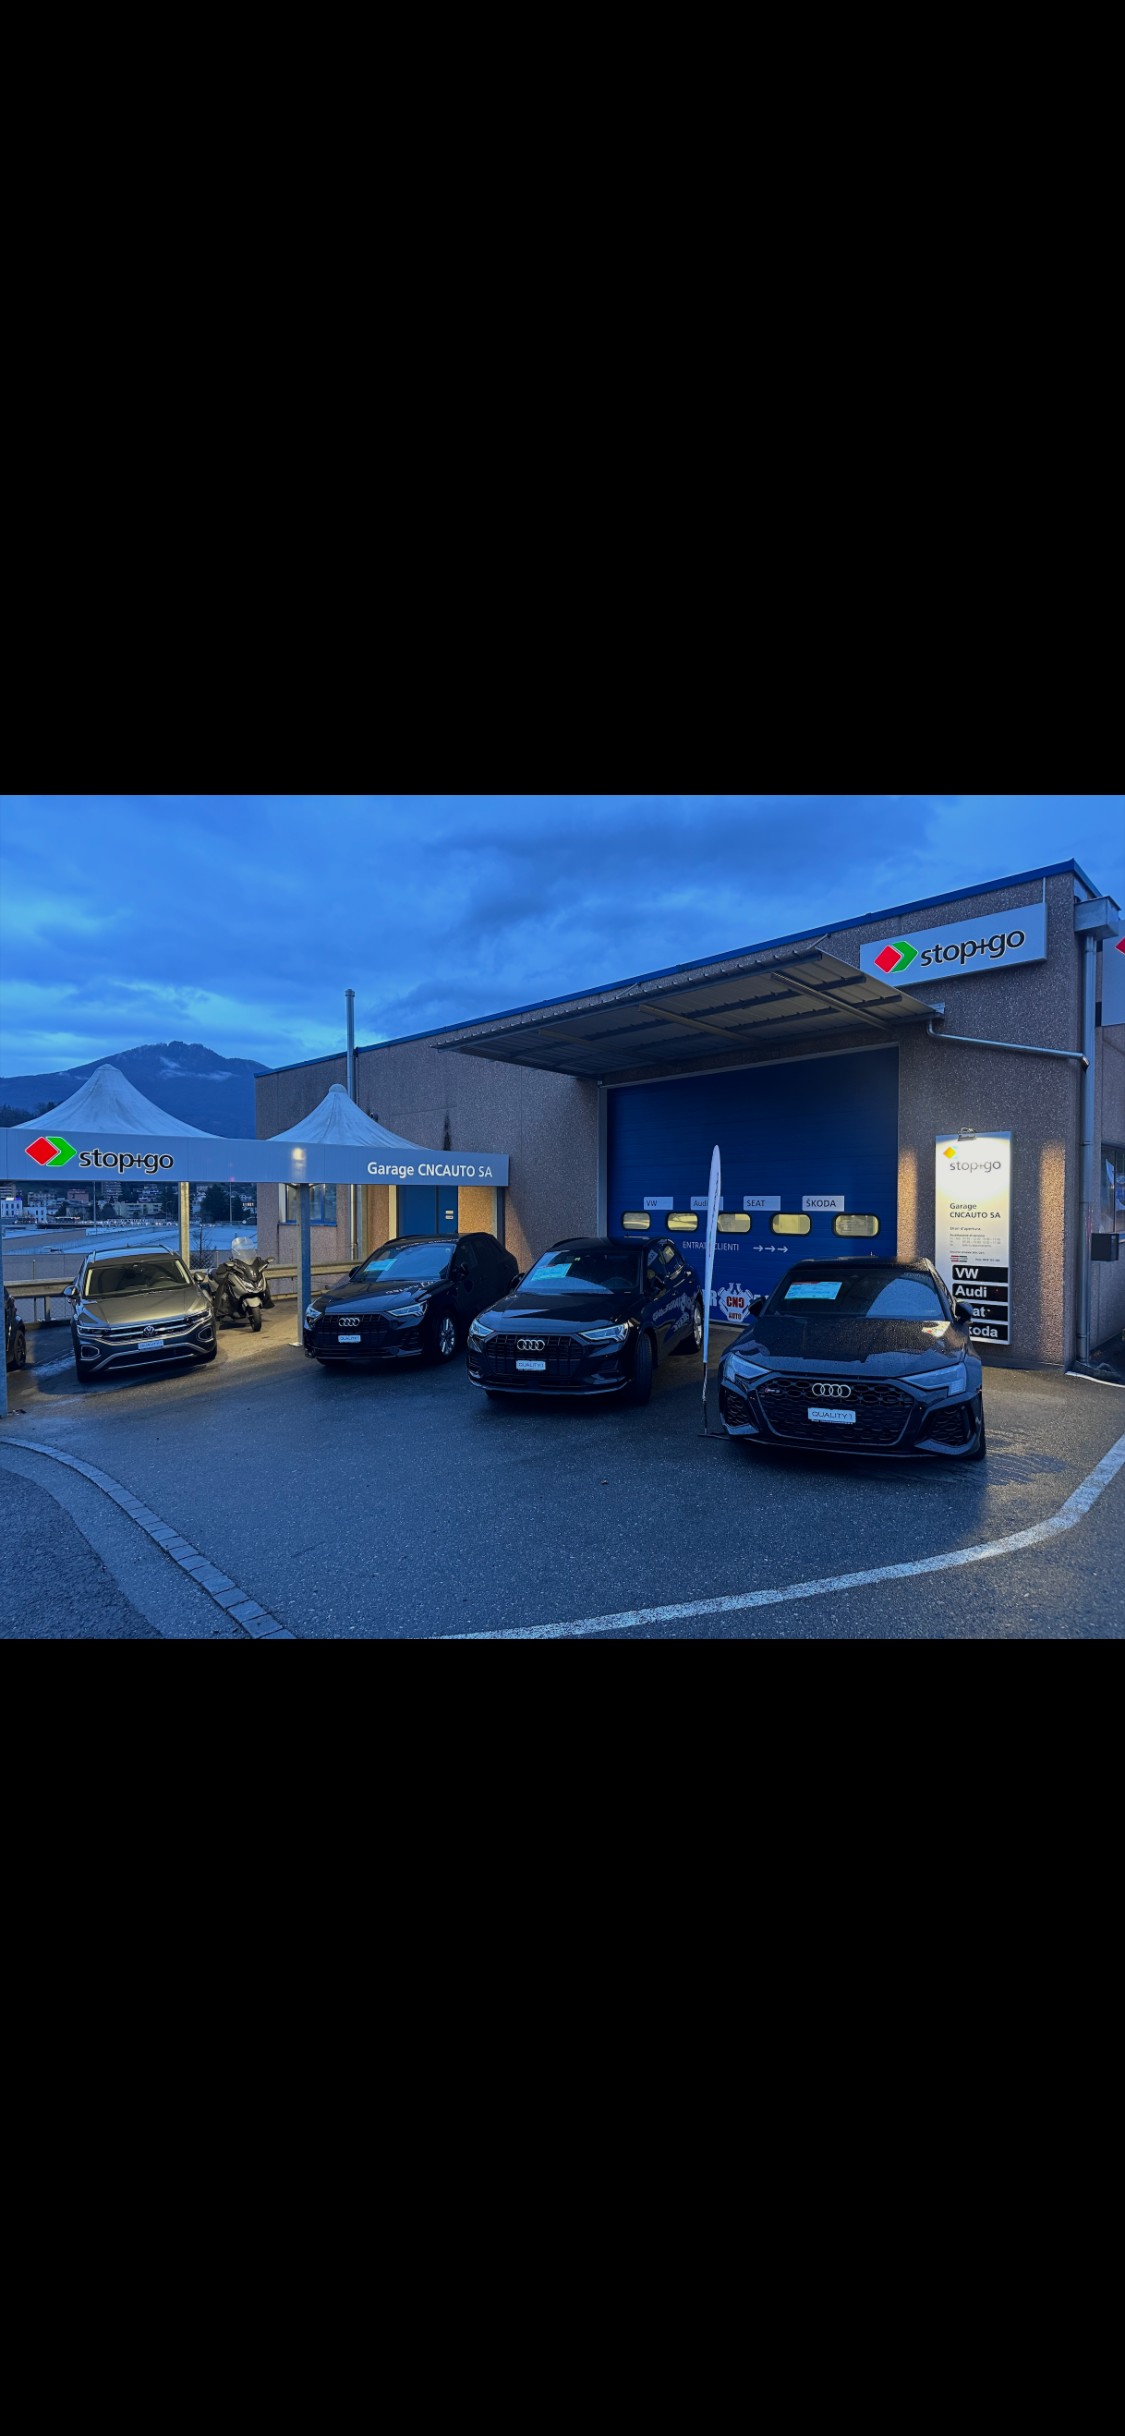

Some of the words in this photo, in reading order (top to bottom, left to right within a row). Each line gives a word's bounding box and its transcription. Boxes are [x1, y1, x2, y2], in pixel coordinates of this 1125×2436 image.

[920, 929, 1026, 967] stop+go
[79, 1148, 175, 1175] stop+go
[949, 1160, 1002, 1173] stop+go
[367, 1161, 415, 1179] Garage
[418, 1163, 476, 1178] CNCAUTO
[478, 1165, 493, 1178] SA
[646, 1199, 658, 1207] VW
[747, 1199, 765, 1207] SEAT
[805, 1198, 837, 1208] ŠKODA
[949, 1202, 978, 1212] Garage
[949, 1211, 988, 1219] CNCAUTO
[990, 1211, 1001, 1219] SA
[955, 1267, 979, 1279] VW
[955, 1285, 988, 1298] Audi
[812, 1411, 847, 1420] QUALITY
